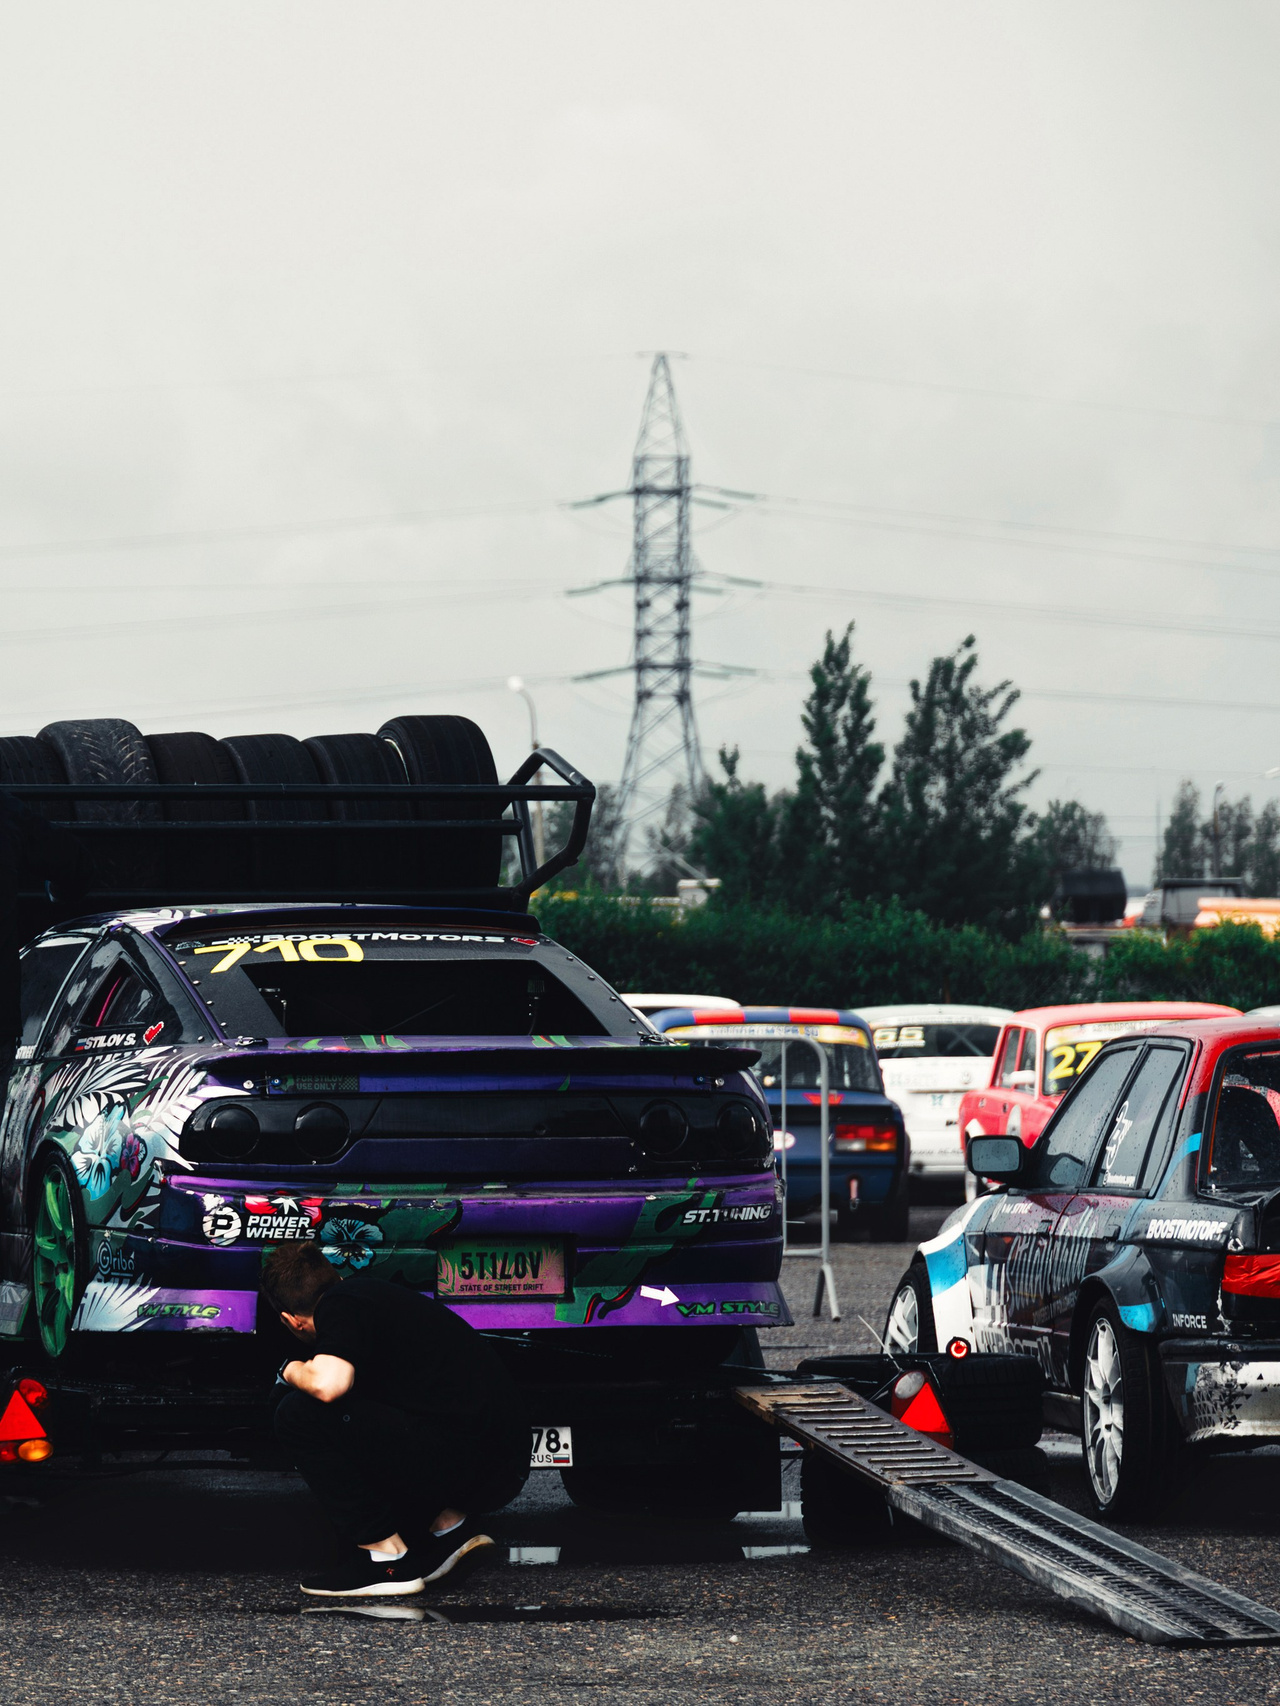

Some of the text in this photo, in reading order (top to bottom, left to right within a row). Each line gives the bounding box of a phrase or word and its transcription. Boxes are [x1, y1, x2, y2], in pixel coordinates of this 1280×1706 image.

[262, 932, 506, 943] BOOSTMOTORS
[194, 939, 365, 973] 710
[84, 1034, 125, 1049] STILOV
[1048, 1041, 1103, 1080] 27
[314, 1082, 337, 1090] ONLY
[247, 1215, 311, 1228] POWER
[246, 1227, 316, 1239] WHEELS
[460, 1284, 482, 1292] STATE
[137, 1303, 220, 1318] VM STYLE
[677, 1301, 780, 1317] VM STYLE
[531, 1428, 561, 1453] 78
